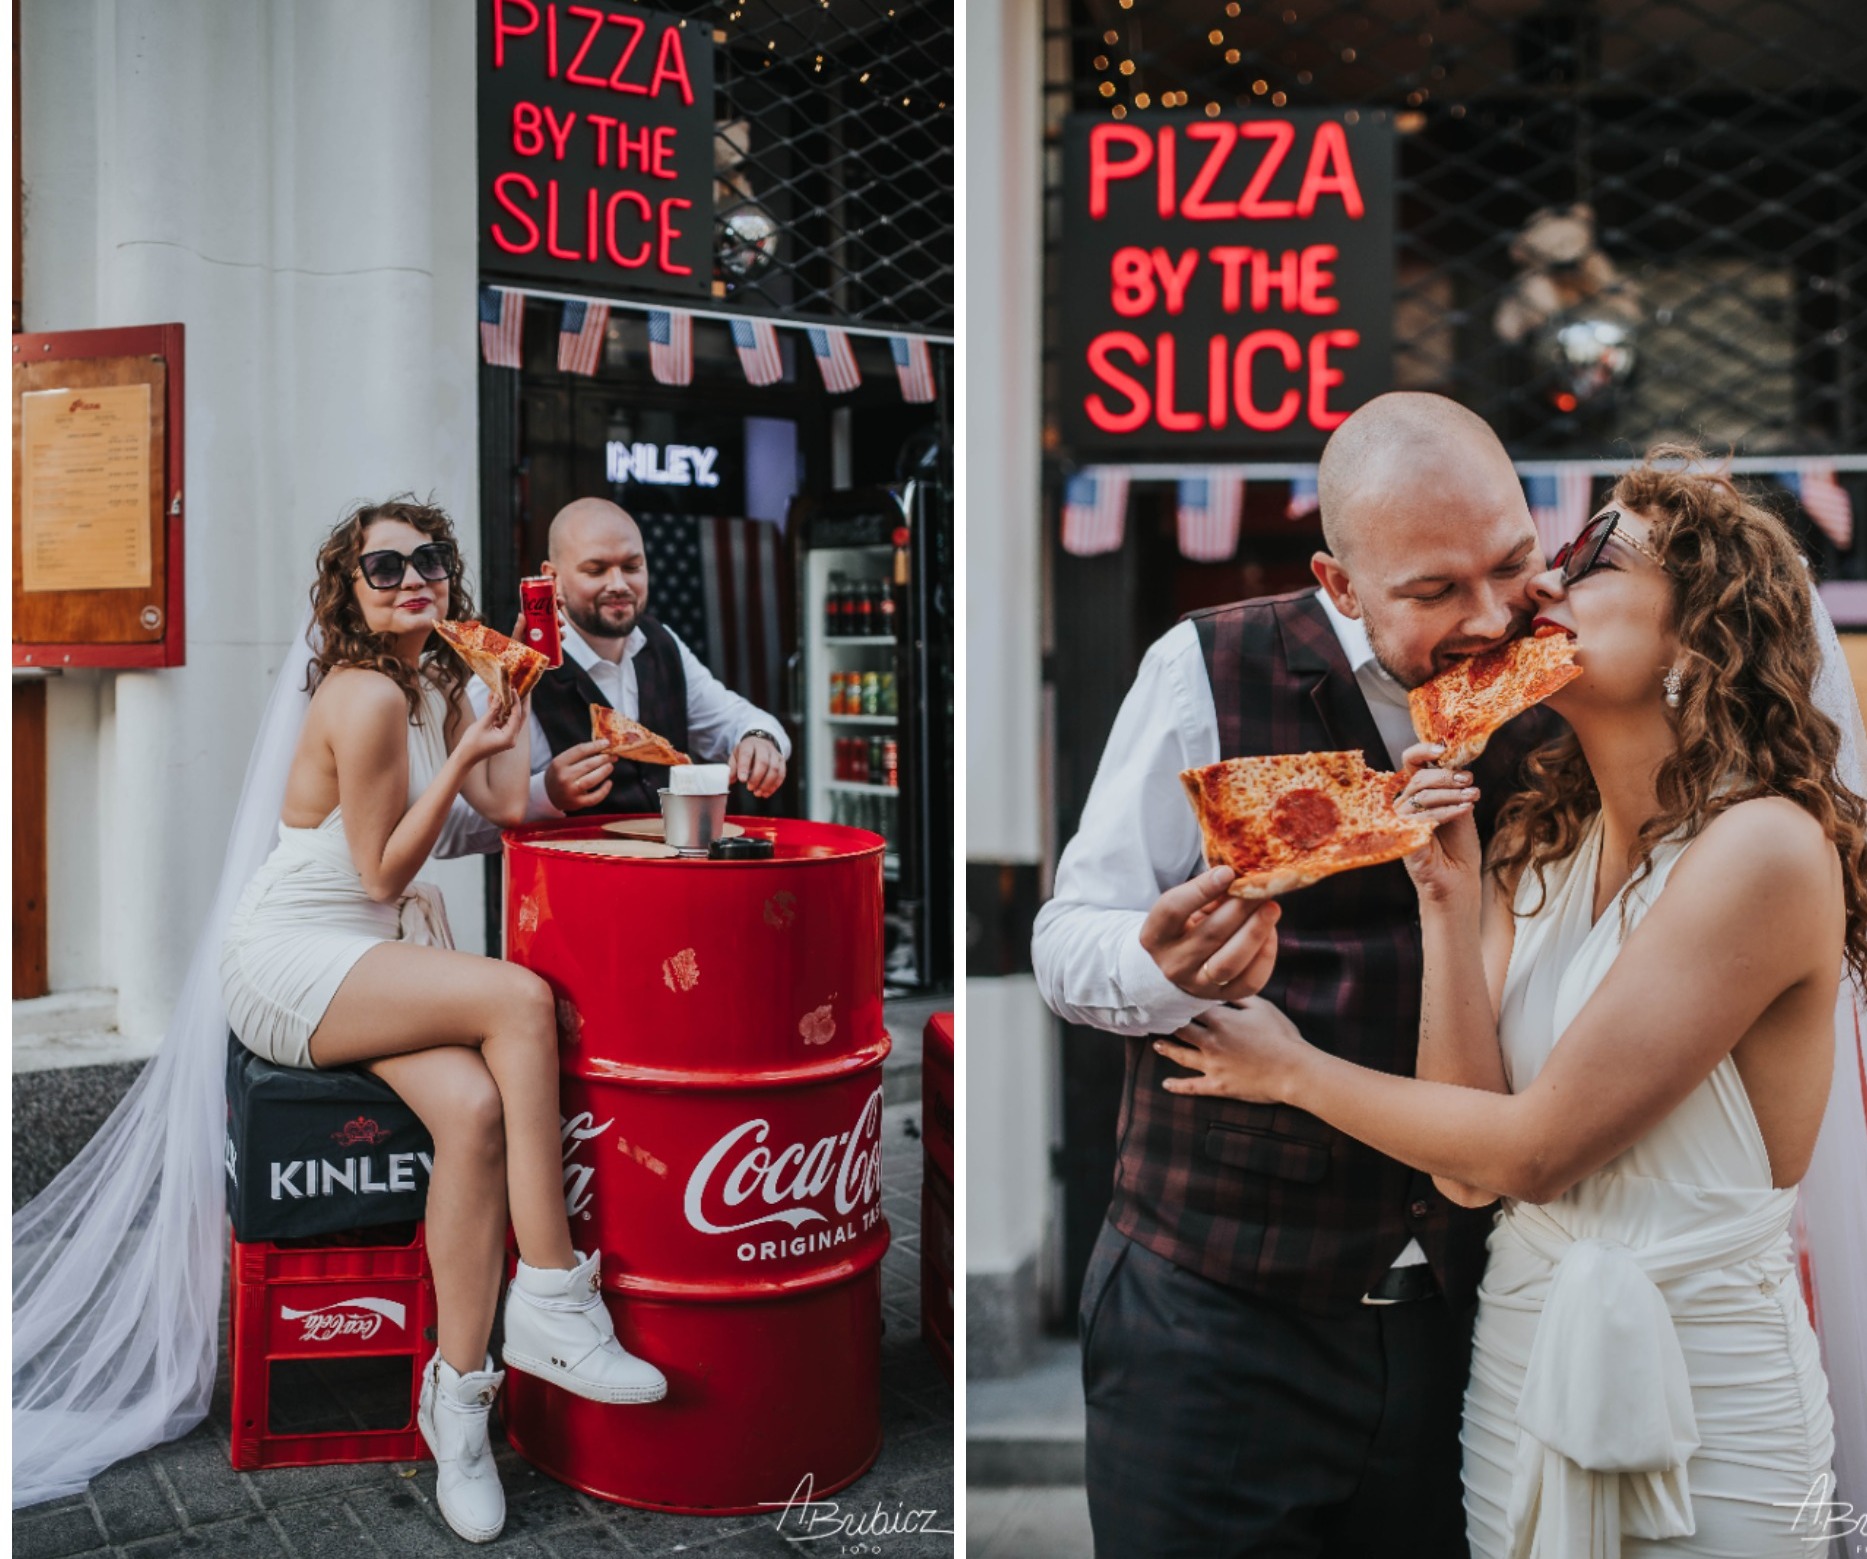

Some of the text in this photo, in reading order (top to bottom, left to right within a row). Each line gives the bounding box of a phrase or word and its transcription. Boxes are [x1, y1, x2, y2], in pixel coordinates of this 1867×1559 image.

[492, 0, 695, 106] PIZZA
[512, 100, 679, 180] BY THE
[1088, 119, 1365, 221] PIZZA
[490, 171, 693, 276] SLICE
[1110, 243, 1340, 318] BY THE
[1083, 328, 1361, 434] SLICE
[737, 1201, 880, 1262] ORIGINAL TAS
